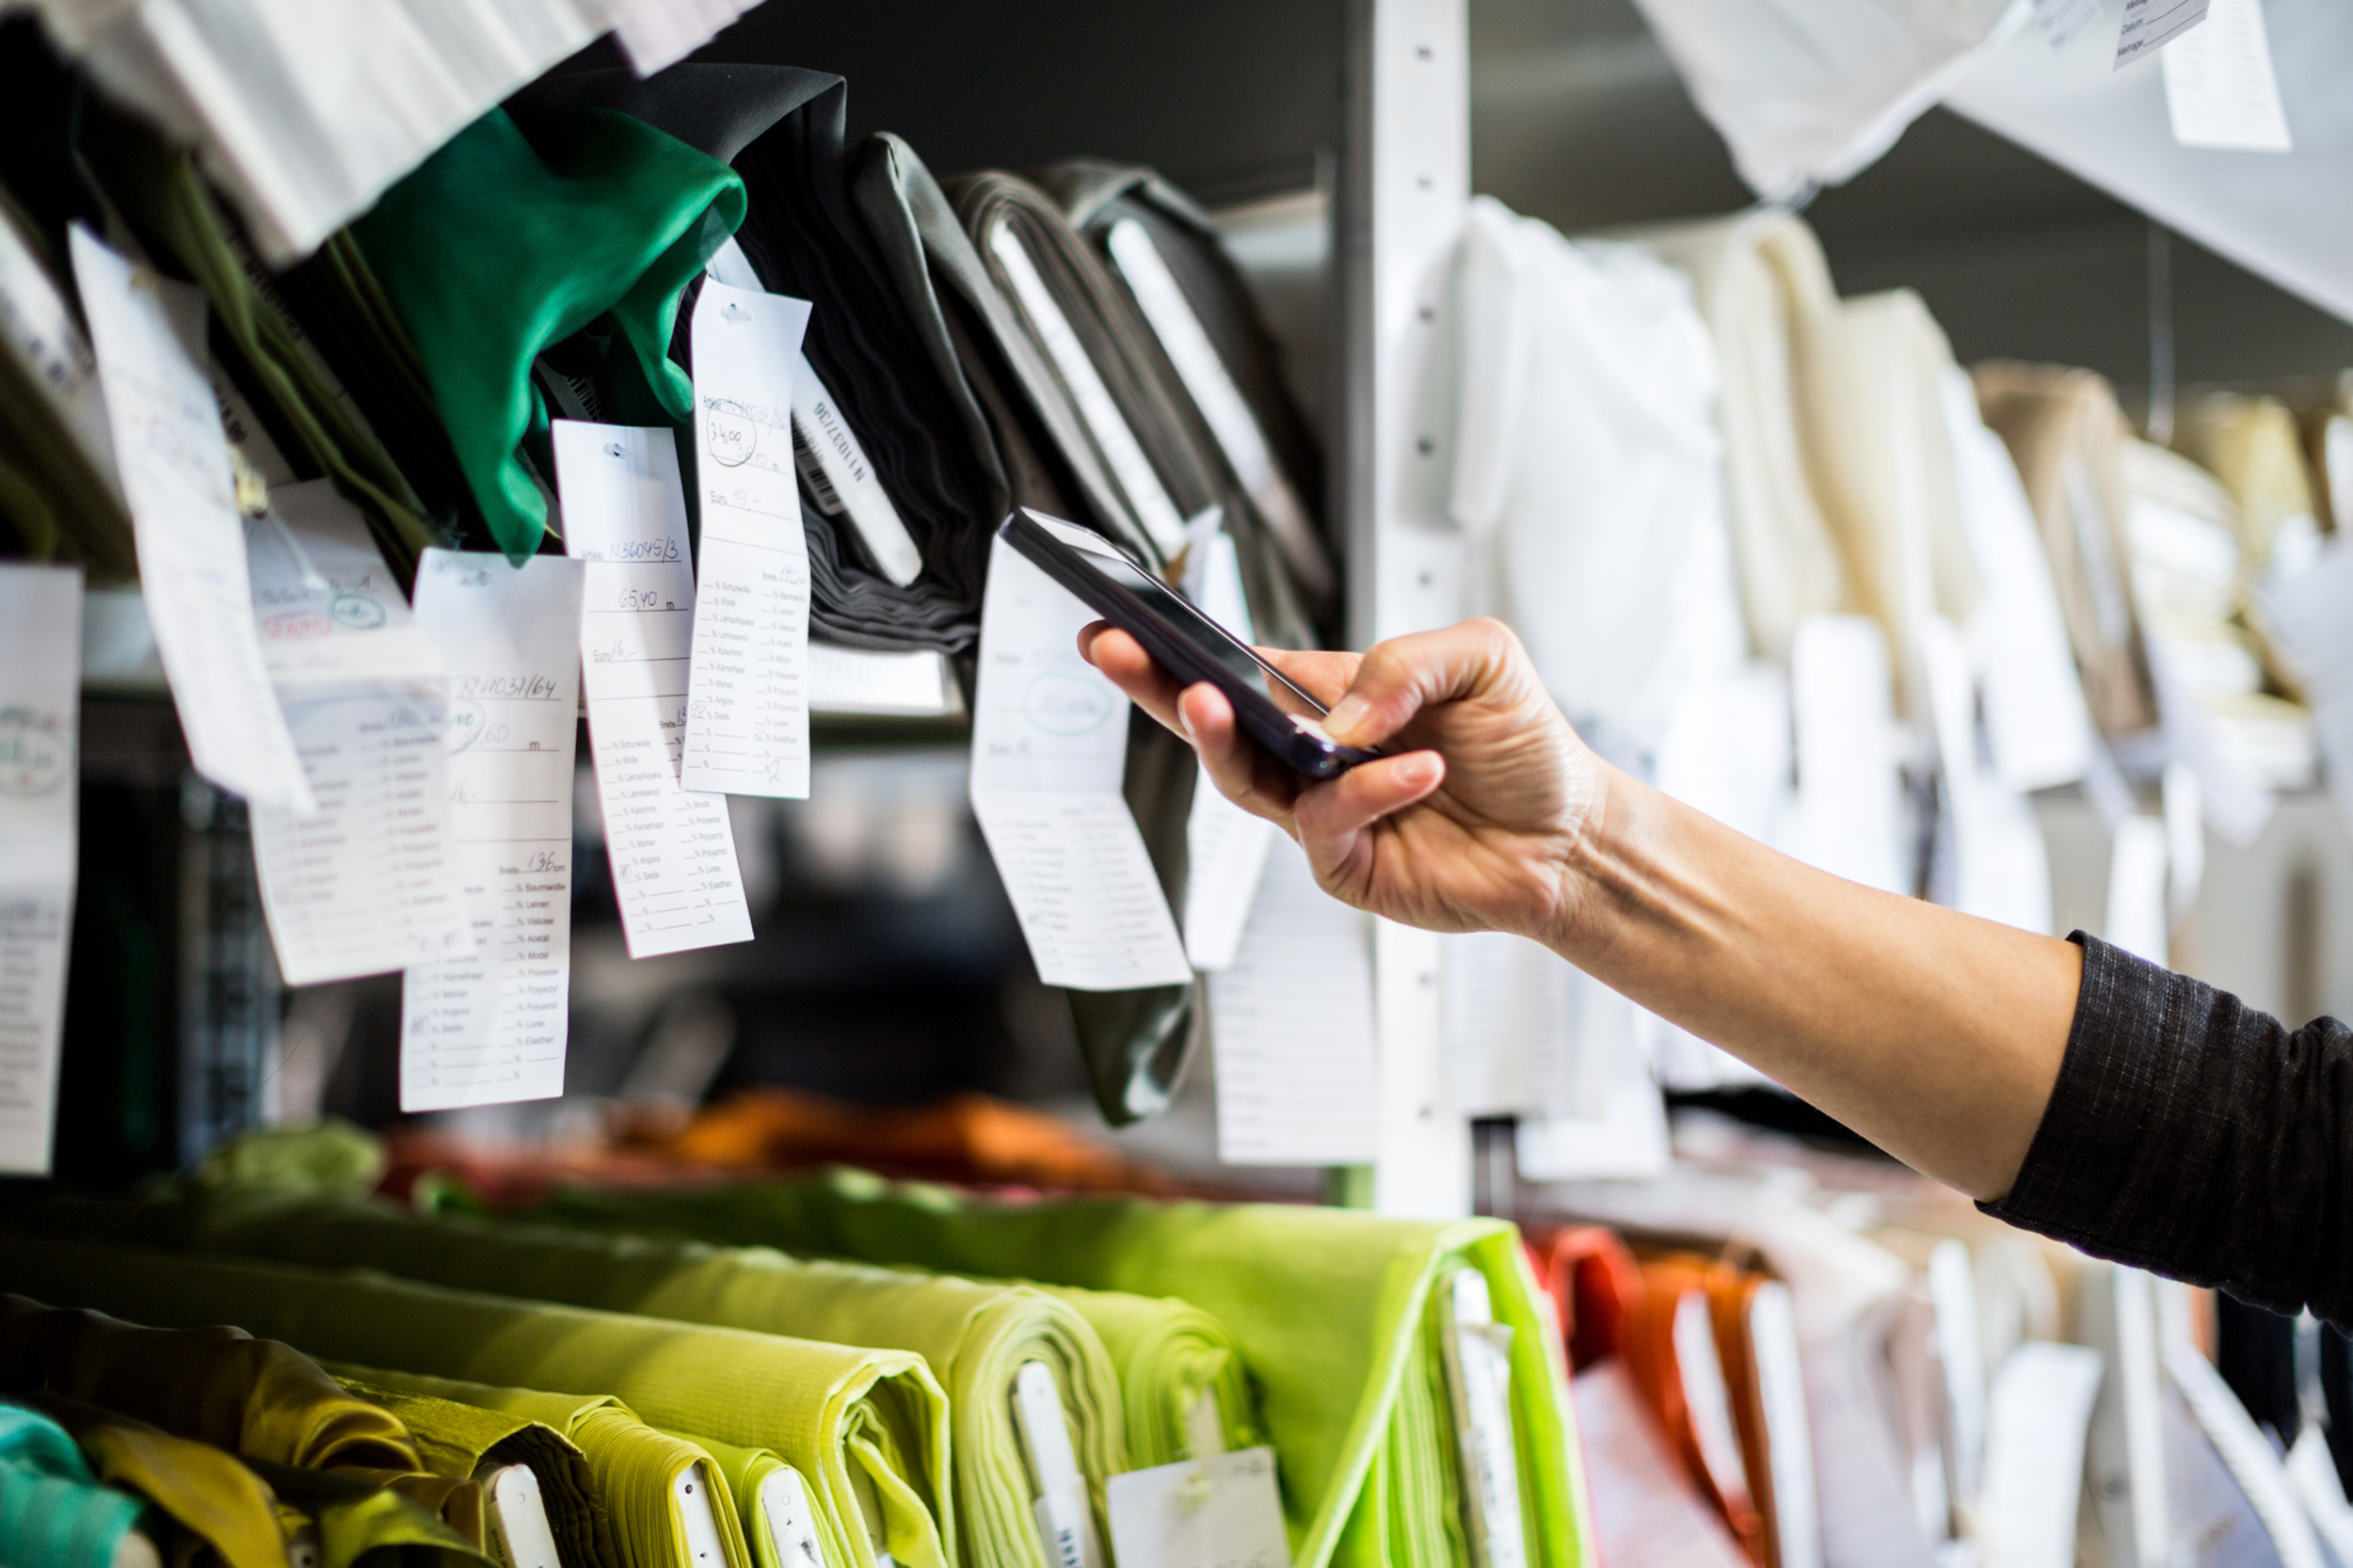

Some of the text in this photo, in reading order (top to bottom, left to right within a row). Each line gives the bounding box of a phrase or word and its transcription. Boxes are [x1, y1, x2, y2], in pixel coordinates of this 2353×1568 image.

[813, 401, 866, 483] N11037/36
[526, 883, 567, 892] Baumwolle
[526, 901, 551, 909] Leinen
[527, 917, 554, 925] Viskose
[528, 950, 551, 959] Modal
